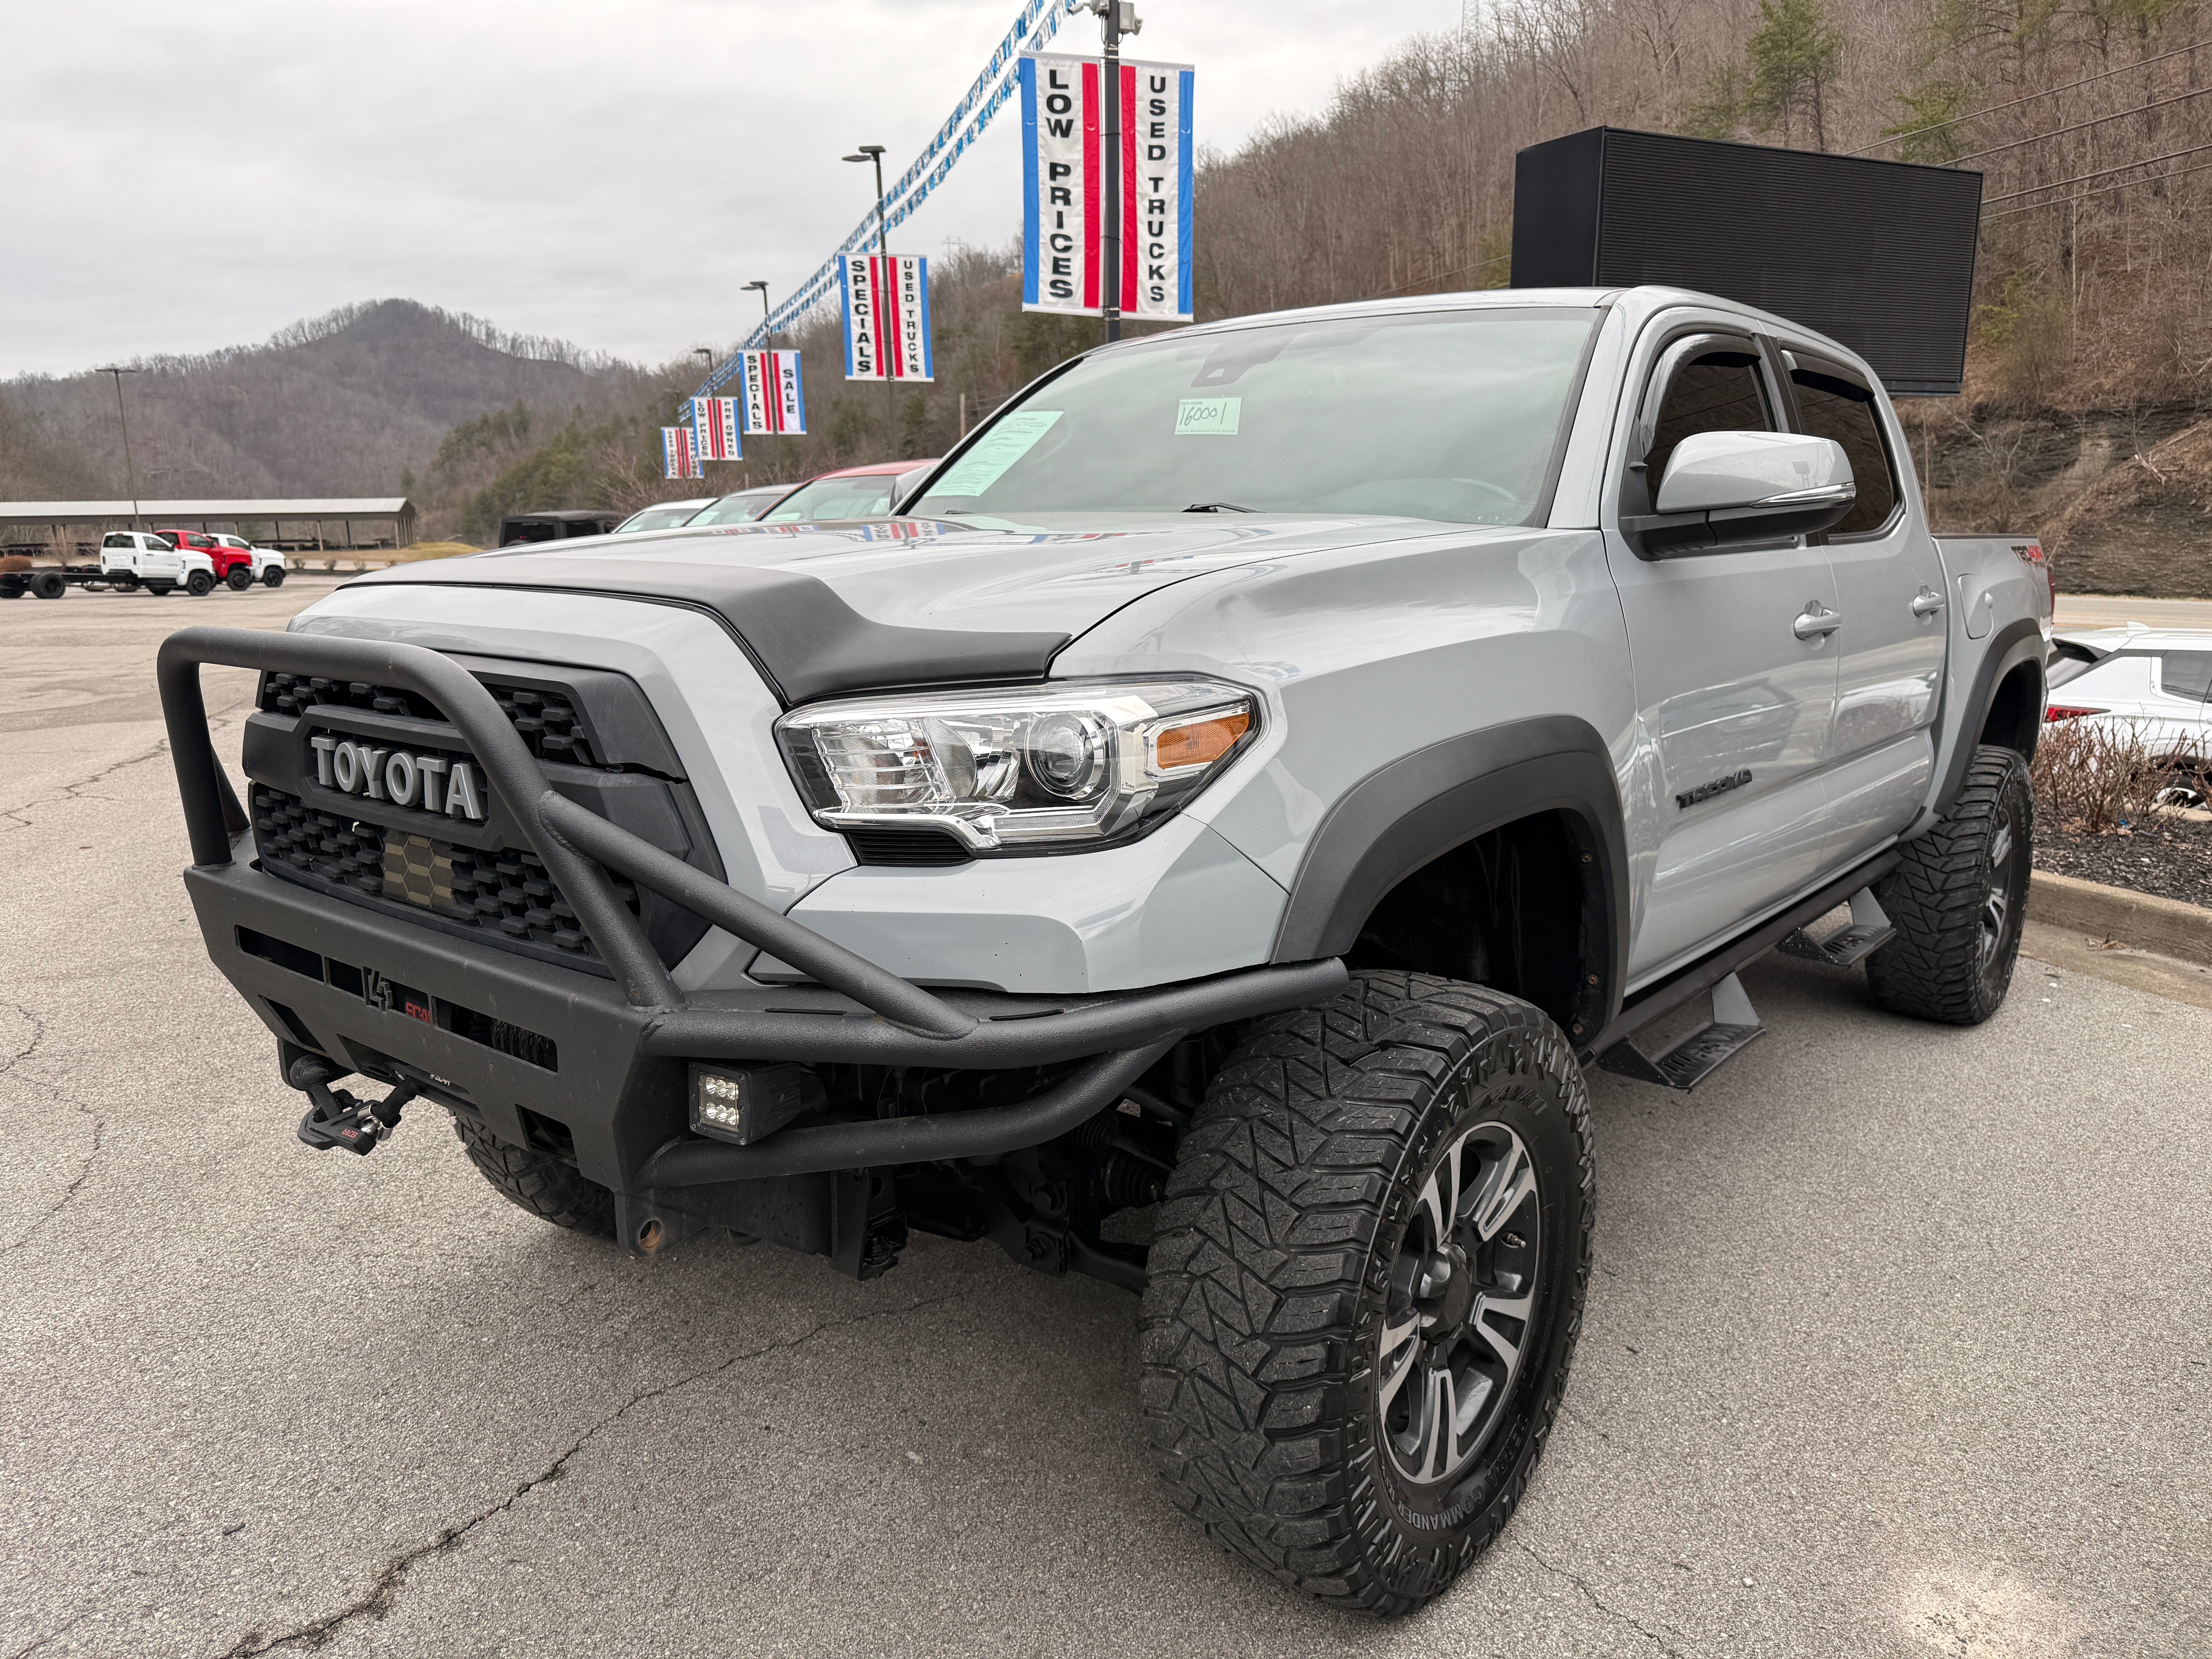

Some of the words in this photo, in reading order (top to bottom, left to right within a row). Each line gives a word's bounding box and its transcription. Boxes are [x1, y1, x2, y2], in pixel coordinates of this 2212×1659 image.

[1046, 69, 1074, 138] LOW
[1147, 76, 1166, 161] USED
[1049, 162, 1073, 299] PRICES
[1147, 177, 1166, 302] TRUCKS
[852, 260, 871, 372] SPECIALS
[903, 261, 914, 302] USED
[907, 310, 919, 373] TRUCKS
[747, 356, 762, 429] SPECIALS
[783, 369, 795, 414] SALE
[726, 426, 734, 455] OWNED
[311, 736, 482, 819] TOYOTA
[1398, 1486, 1486, 1530] COMMANDER
